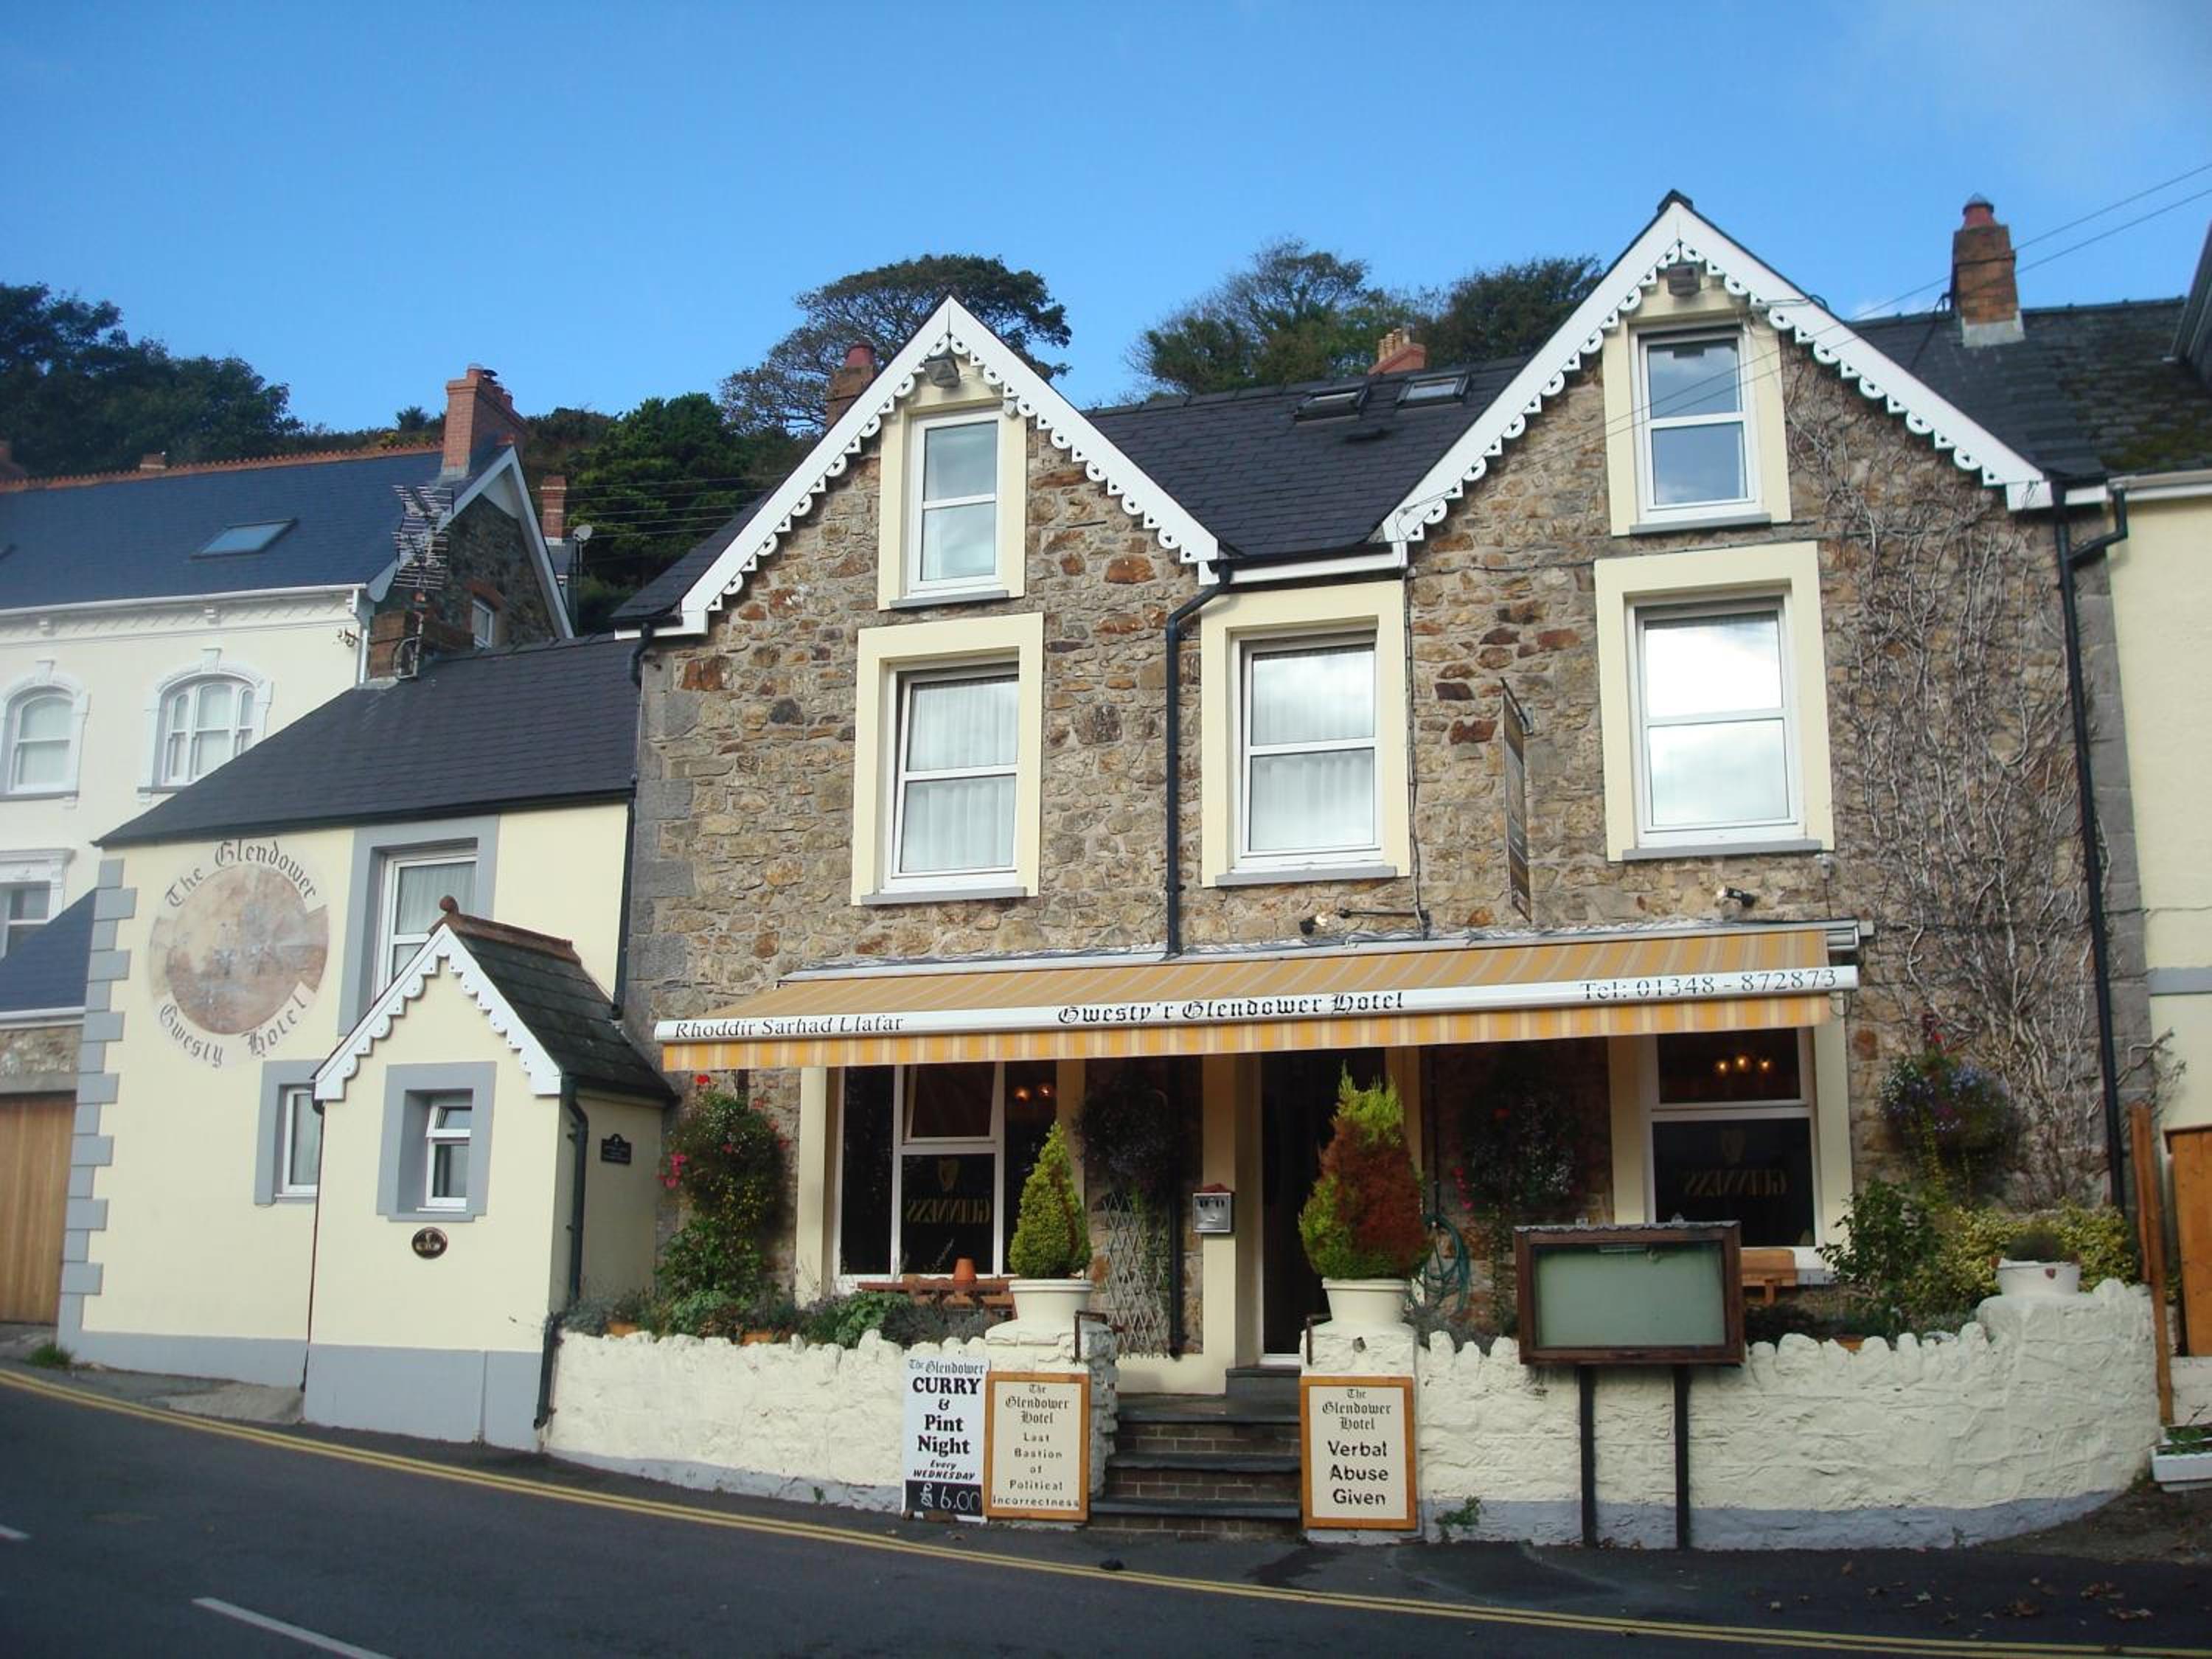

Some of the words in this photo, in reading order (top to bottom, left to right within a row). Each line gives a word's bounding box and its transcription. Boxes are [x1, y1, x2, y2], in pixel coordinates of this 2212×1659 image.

[164, 867, 203, 908] The
[215, 838, 317, 899] Glendower
[1581, 982, 1627, 1000] Tel:
[1636, 975, 1715, 998] 01348
[1741, 970, 1837, 991] 872873
[1057, 1002, 1175, 1024] Gwesty'r
[1182, 997, 1323, 1020] Glendower
[1330, 992, 1405, 1015] Hotel
[159, 1003, 223, 1068] Gwesty
[240, 993, 307, 1057] Hotel
[675, 1021, 757, 1039] Rhoddir
[762, 1017, 832, 1035] Sarhad
[839, 1015, 905, 1032] Llafar
[909, 1358, 925, 1371] The
[925, 1361, 985, 1375] Glendower
[912, 1376, 982, 1395] CURRY
[1029, 1383, 1046, 1394] The
[1346, 1388, 1367, 1399] The
[938, 1398, 950, 1411] &
[1004, 1395, 1071, 1411] Glendower
[1322, 1401, 1391, 1415] Glendower
[924, 1413, 964, 1433] Pint
[1020, 1410, 1054, 1427] Hotel
[1339, 1416, 1376, 1432] Hotel
[1023, 1431, 1050, 1443] Last
[917, 1434, 971, 1458] Night
[1014, 1447, 1063, 1459] Bastion
[1328, 1440, 1388, 1457] Verbal
[930, 1458, 957, 1470] Every
[1029, 1464, 1043, 1475] of
[1329, 1463, 1389, 1481] Abuse
[913, 1470, 975, 1481] WEDNESDAY
[1009, 1479, 1063, 1492] Political
[1332, 1488, 1386, 1506] Given
